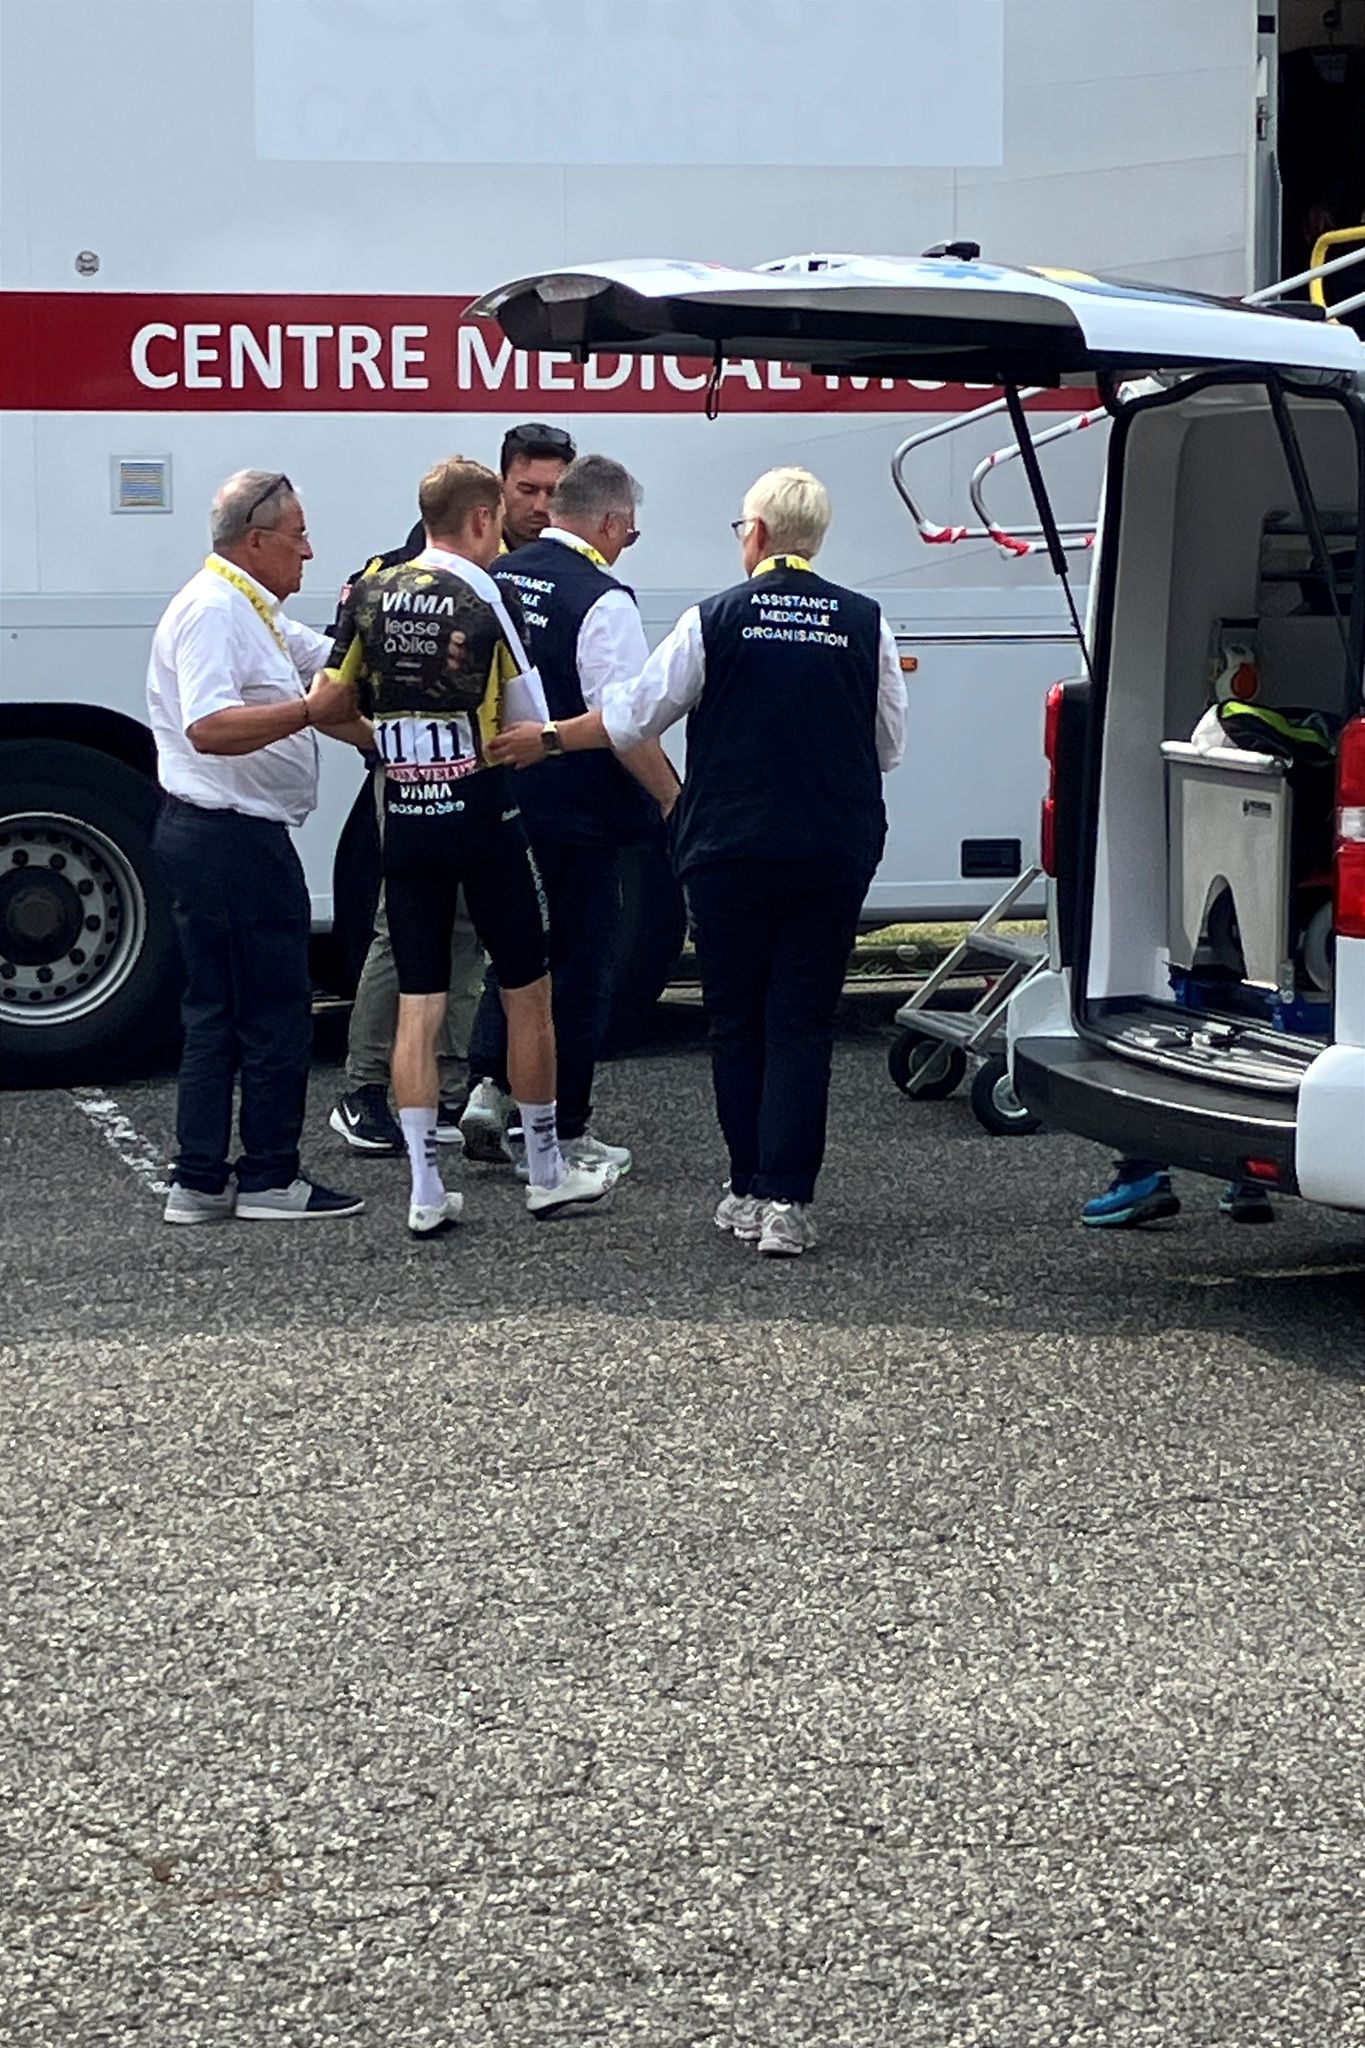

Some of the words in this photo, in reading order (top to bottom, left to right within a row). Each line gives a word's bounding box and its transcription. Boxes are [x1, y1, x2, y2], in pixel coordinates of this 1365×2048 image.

[131, 323, 429, 390] CENTRE
[458, 325, 801, 391] MEDICAL
[382, 590, 454, 616] VISMA
[751, 593, 839, 612] ASSISTANCE
[384, 617, 440, 637] lease
[760, 608, 830, 626] MEDICALE
[742, 627, 848, 648] ORGANISATION
[377, 721, 407, 763] 11
[426, 721, 466, 763] 11
[400, 782, 452, 800] VISMA
